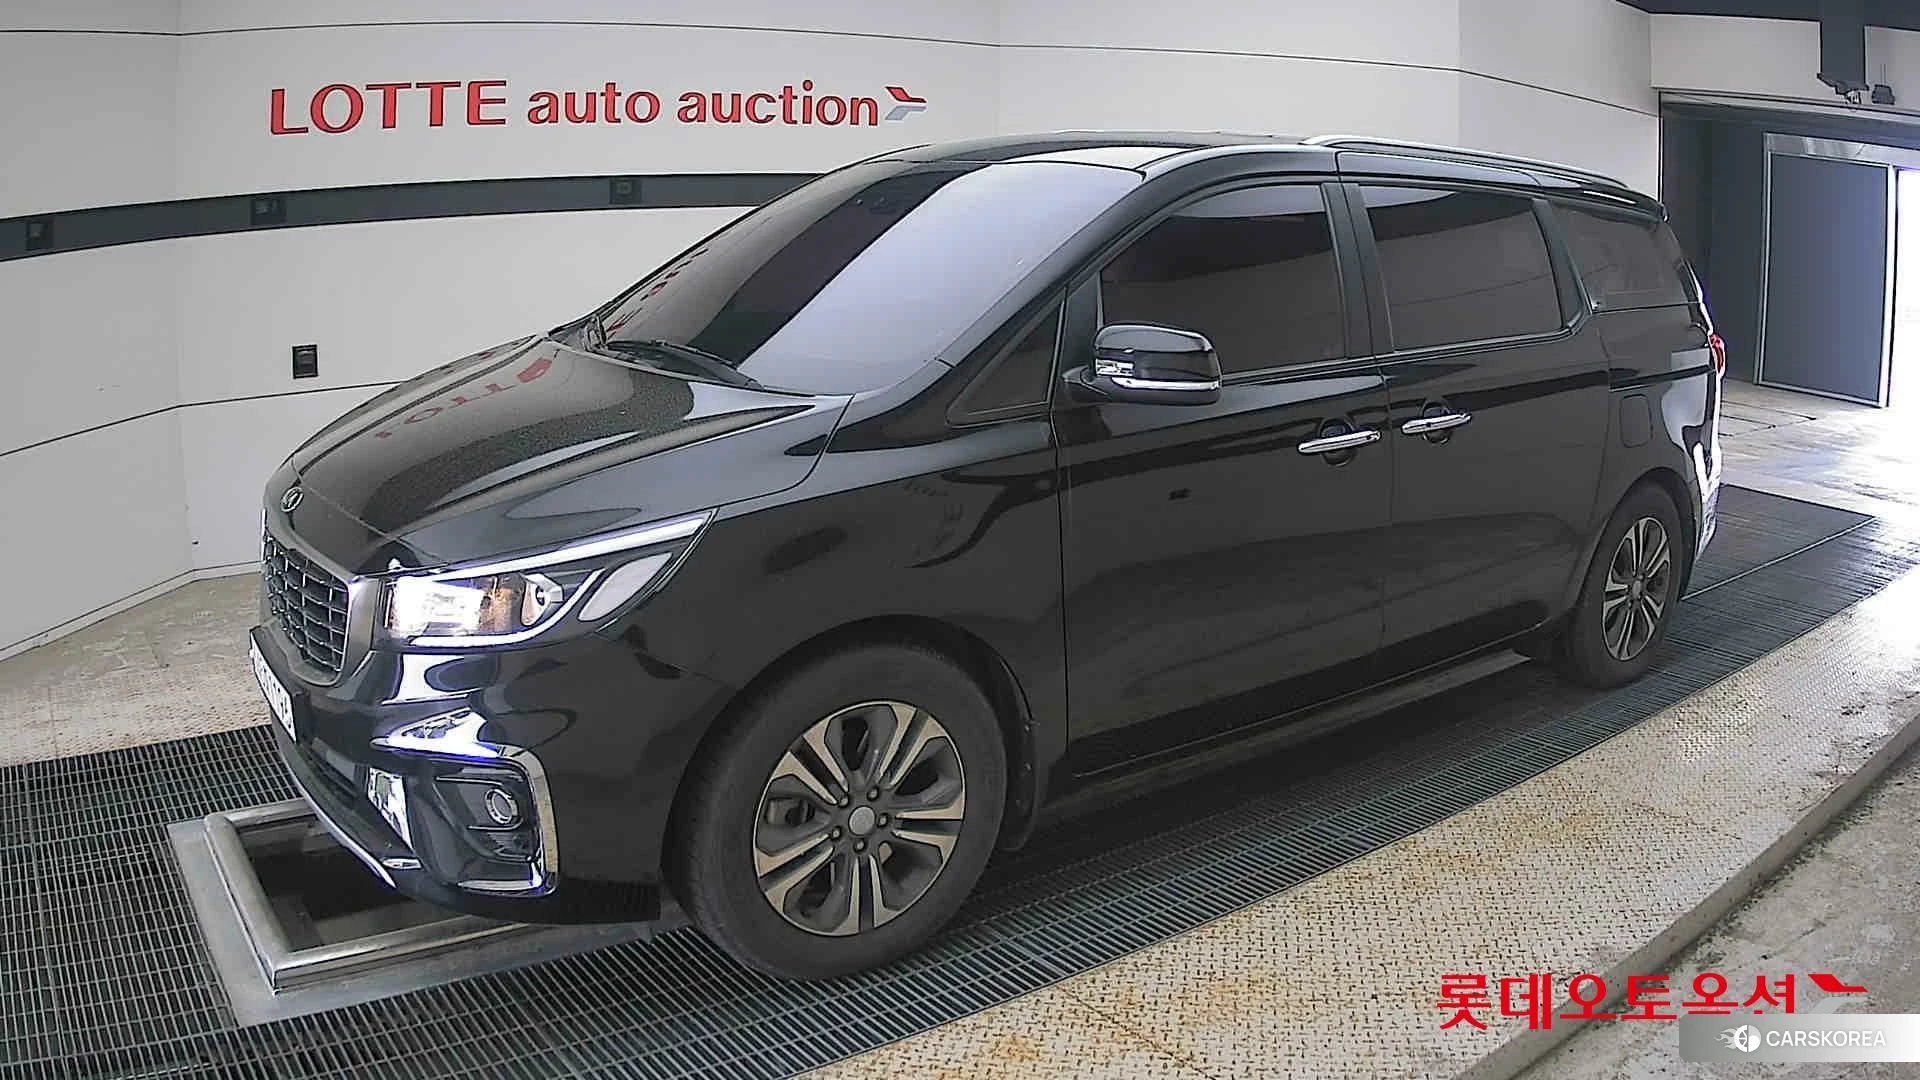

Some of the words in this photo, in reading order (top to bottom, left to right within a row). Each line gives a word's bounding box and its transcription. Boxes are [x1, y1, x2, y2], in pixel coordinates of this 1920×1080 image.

[270, 80, 507, 135] LOTTE
[527, 81, 661, 125] auto
[677, 80, 880, 126] auction
